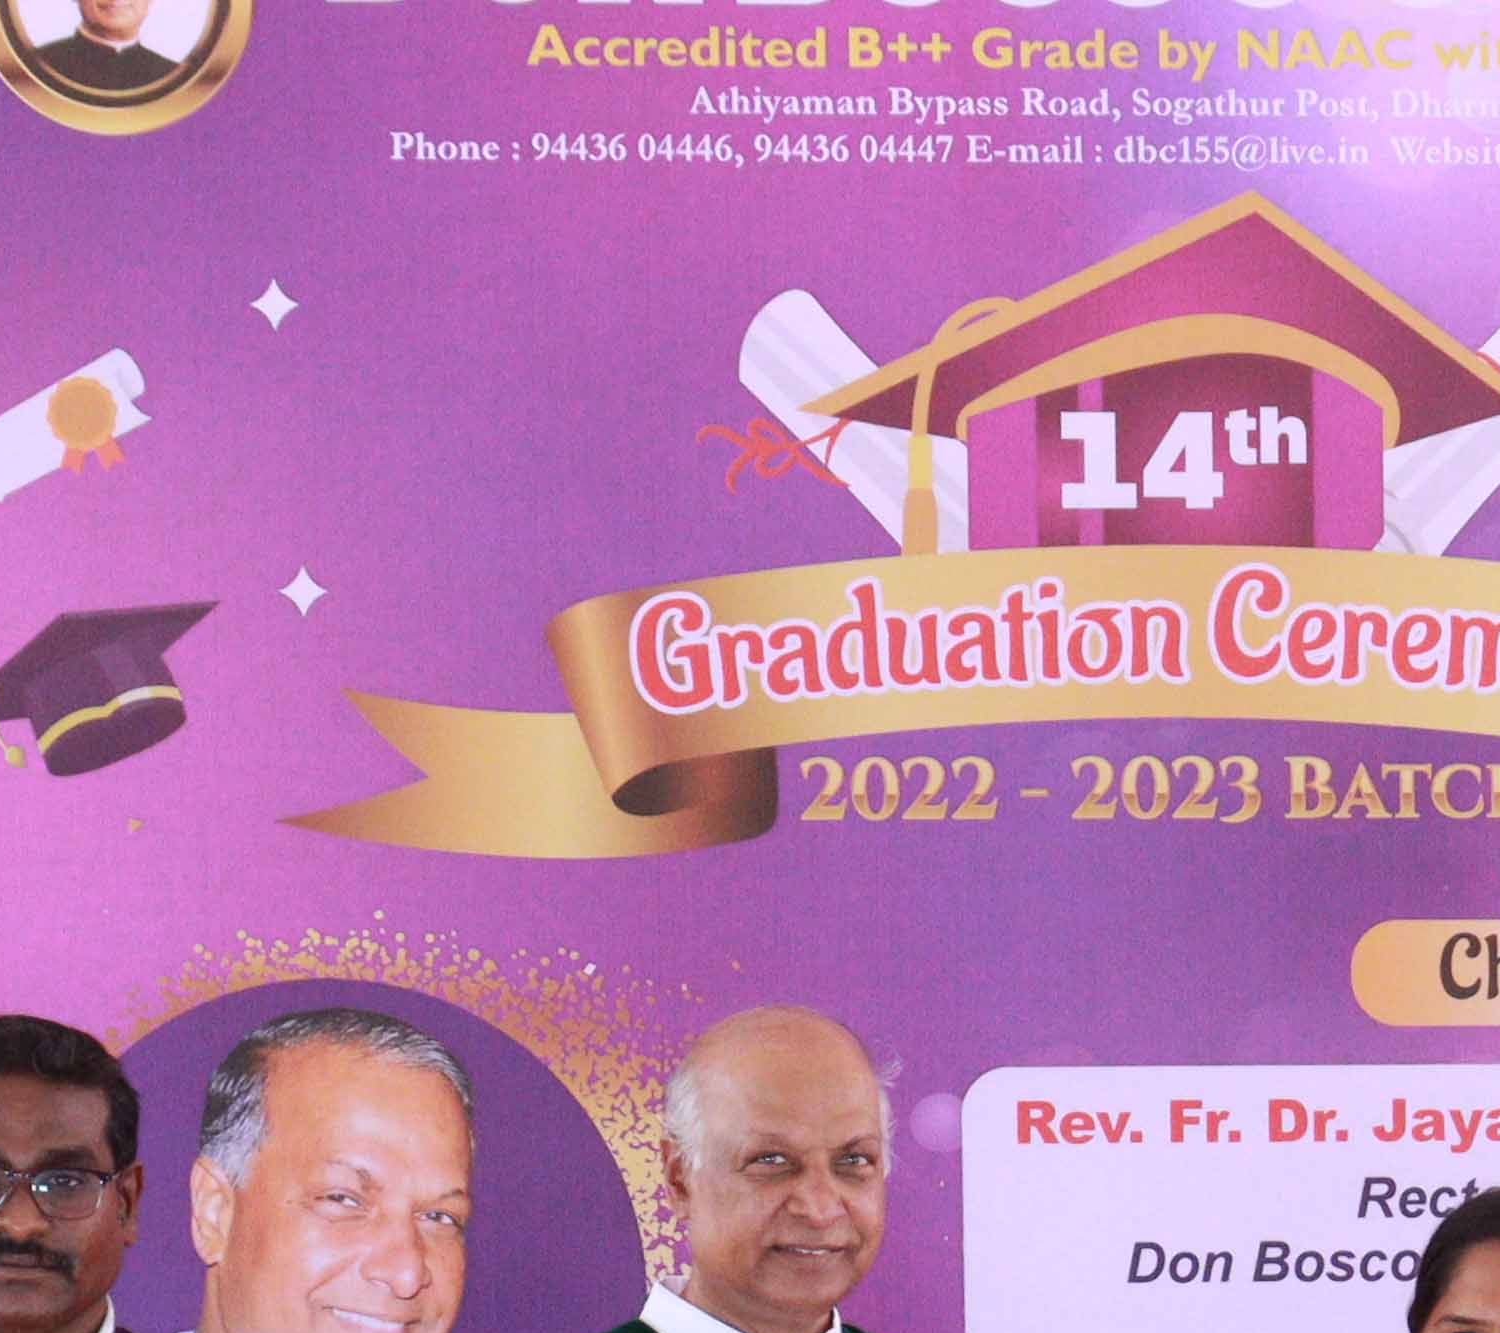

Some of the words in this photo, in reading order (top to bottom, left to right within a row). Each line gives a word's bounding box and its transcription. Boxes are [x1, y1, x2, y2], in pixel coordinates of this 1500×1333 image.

[526, 23, 829, 68] Accredited
[848, 26, 952, 68] B++
[972, 27, 1140, 70] Grade
[1159, 28, 1217, 81] by
[1237, 26, 1414, 71] NAAC
[689, 85, 877, 124] Athiyaman
[887, 87, 1009, 124] Bypass
[1021, 89, 1122, 123] Road,
[1132, 87, 1285, 126] Sogathur
[1296, 88, 1380, 124] Post,
[390, 131, 500, 161] Phone
[531, 132, 628, 163] 94436
[637, 133, 745, 167] 04446,
[753, 133, 850, 163] 94436
[859, 135, 955, 164] 04447
[966, 135, 1084, 165] E-mail
[1113, 134, 1370, 171] dbc155@live.in
[1060, 406, 1307, 509] 14th
[633, 580, 1188, 712] Graduation
[800, 755, 998, 821] 2022
[1070, 755, 1262, 823] 2023
[1016, 1100, 1143, 1144] Rev.
[1169, 1100, 1241, 1143] Fr.
[1268, 1099, 1348, 1142] Dr.
[1127, 1241, 1233, 1284] Don
[1253, 1241, 1421, 1283] Bosco
